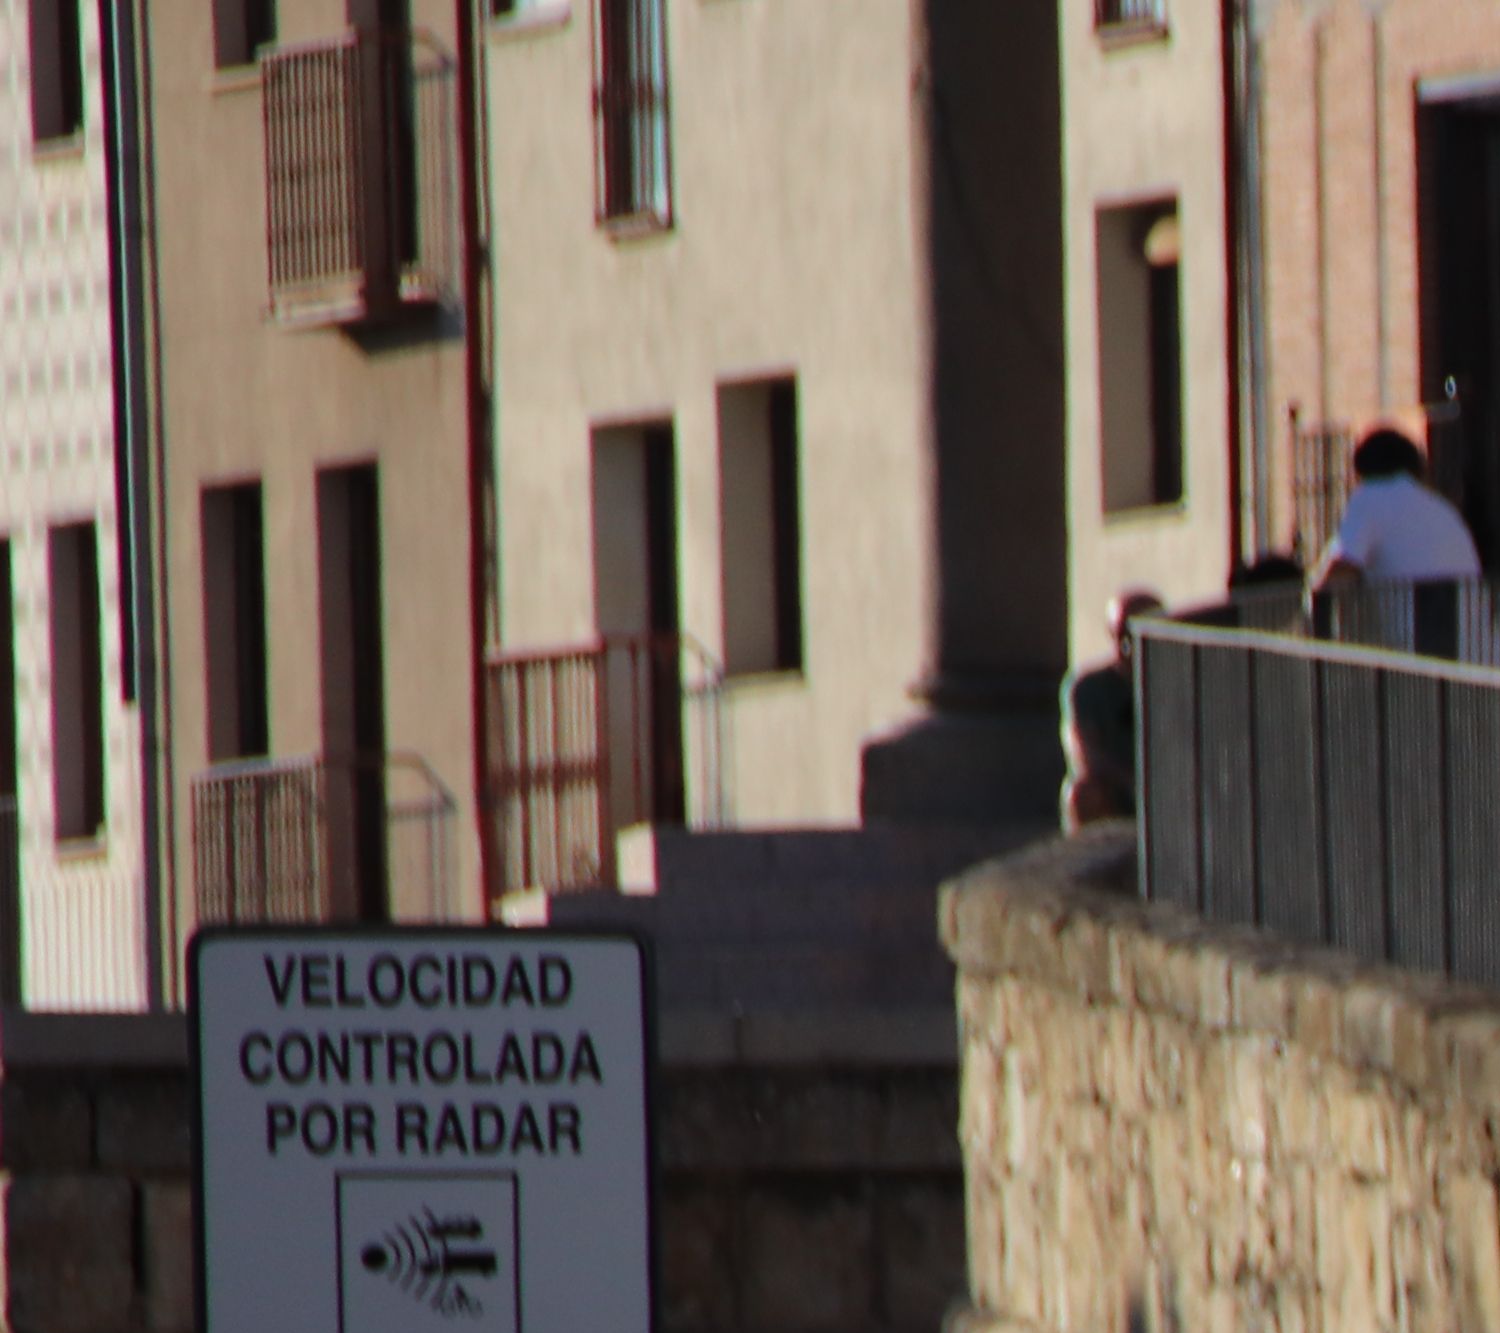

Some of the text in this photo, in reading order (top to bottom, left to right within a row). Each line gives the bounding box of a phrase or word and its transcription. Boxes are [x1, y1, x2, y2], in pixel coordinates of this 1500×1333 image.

[263, 953, 573, 1008] VELOCIDAD
[238, 1030, 602, 1086] CONTROLADA
[266, 1102, 582, 1156] POR RADAR
